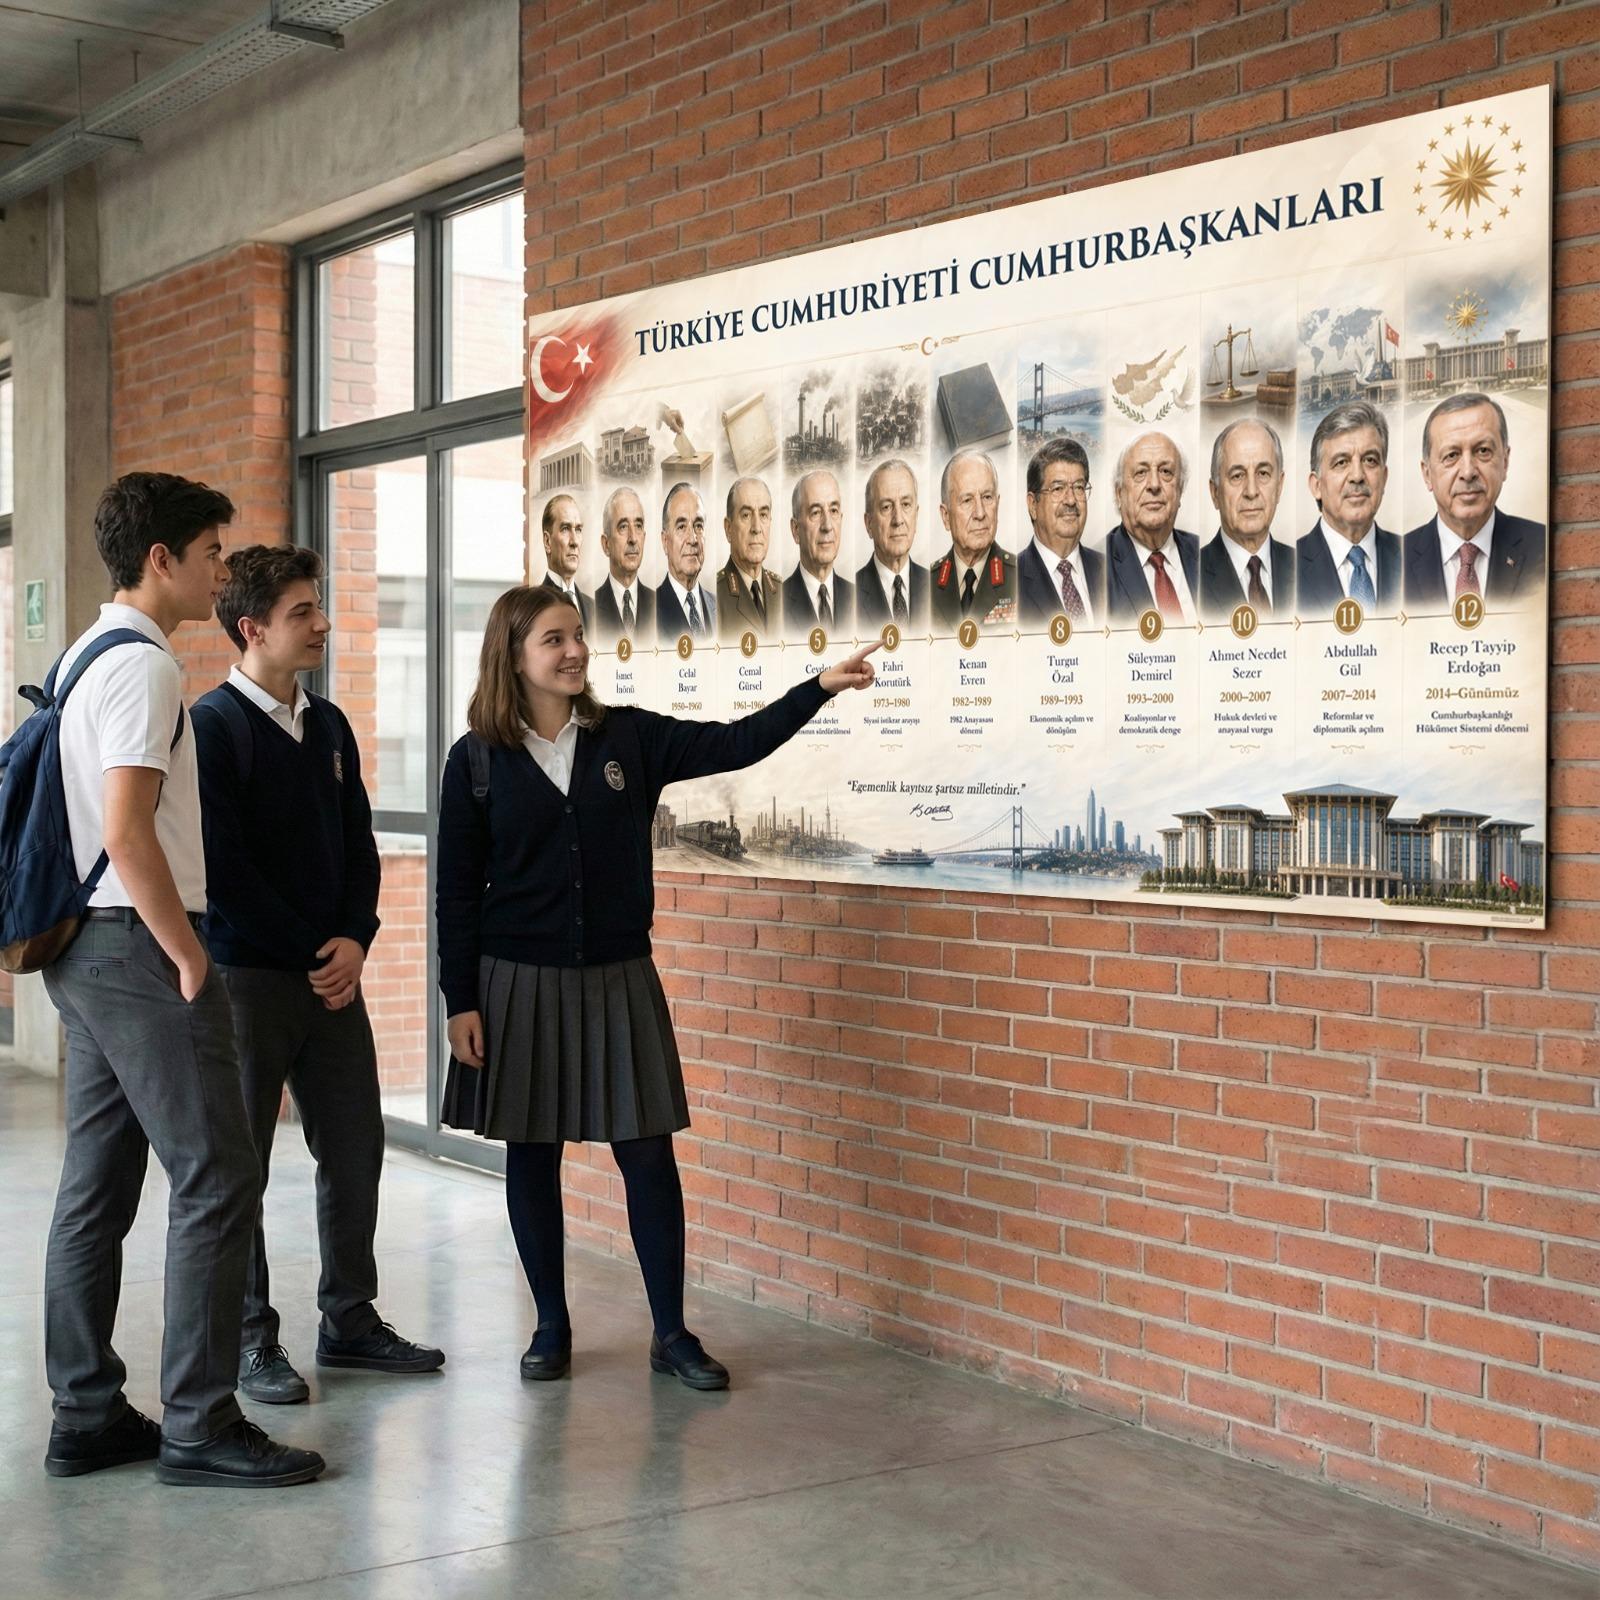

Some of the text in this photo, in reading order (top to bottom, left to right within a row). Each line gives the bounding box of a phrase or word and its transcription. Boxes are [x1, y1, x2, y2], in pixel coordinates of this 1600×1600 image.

[635, 176, 1385, 356] TÜRKİYE CUMHURİYETİ CUMHURBAŞKANLARI
[1459, 599, 1479, 622] 12
[1236, 610, 1253, 632] 10
[1341, 606, 1356, 628] 11
[1055, 620, 1065, 640] 8
[1146, 616, 1156, 636] 9
[886, 629, 895, 647] 6
[963, 625, 972, 643] 7
[744, 636, 753, 653] 4
[814, 632, 822, 650] 5
[621, 641, 628, 657] 2
[681, 639, 689, 656] 3
[1324, 644, 1377, 658] Abdullah
[1430, 639, 1516, 656] Recep Tayyip
[1128, 652, 1176, 666] Süleyman
[1208, 648, 1286, 662] Ahmet Necdet
[882, 661, 903, 672] Fahri
[960, 659, 987, 670] Kenan
[1047, 656, 1079, 668] Turgut
[679, 668, 696, 678] Celal
[739, 666, 761, 676] Cemal
[1232, 667, 1262, 679] Sezer
[1340, 663, 1361, 676] Gül
[1448, 660, 1501, 677] Erdoğan
[960, 675, 985, 686] Evren
[1052, 670, 1073, 683] Özal
[1132, 669, 1172, 681] Demirel
[739, 681, 762, 691] Gürsel
[875, 676, 912, 688] Korutürk
[679, 683, 697, 694] Bayar
[1029, 714, 1063, 723] Ekonomik
[1124, 714, 1166, 723] Koalisyonlar
[1214, 713, 1240, 721] Hukuk
[1242, 713, 1267, 721] devleti
[1323, 712, 1363, 721] Reformlar
[1431, 710, 1512, 722] Cumhurbaşkanlığı
[881, 727, 902, 735] dönemi
[1046, 726, 1077, 736] dönüşüm
[1119, 726, 1181, 736] demokratik denge
[1218, 725, 1273, 736] anayasal vurgu
[1313, 724, 1384, 735] diplomatik açılım
[1416, 723, 1529, 733] Hükümet Sistemi dönemi
[900, 781, 933, 795] kayıtsız
[935, 784, 964, 796] şartsız
